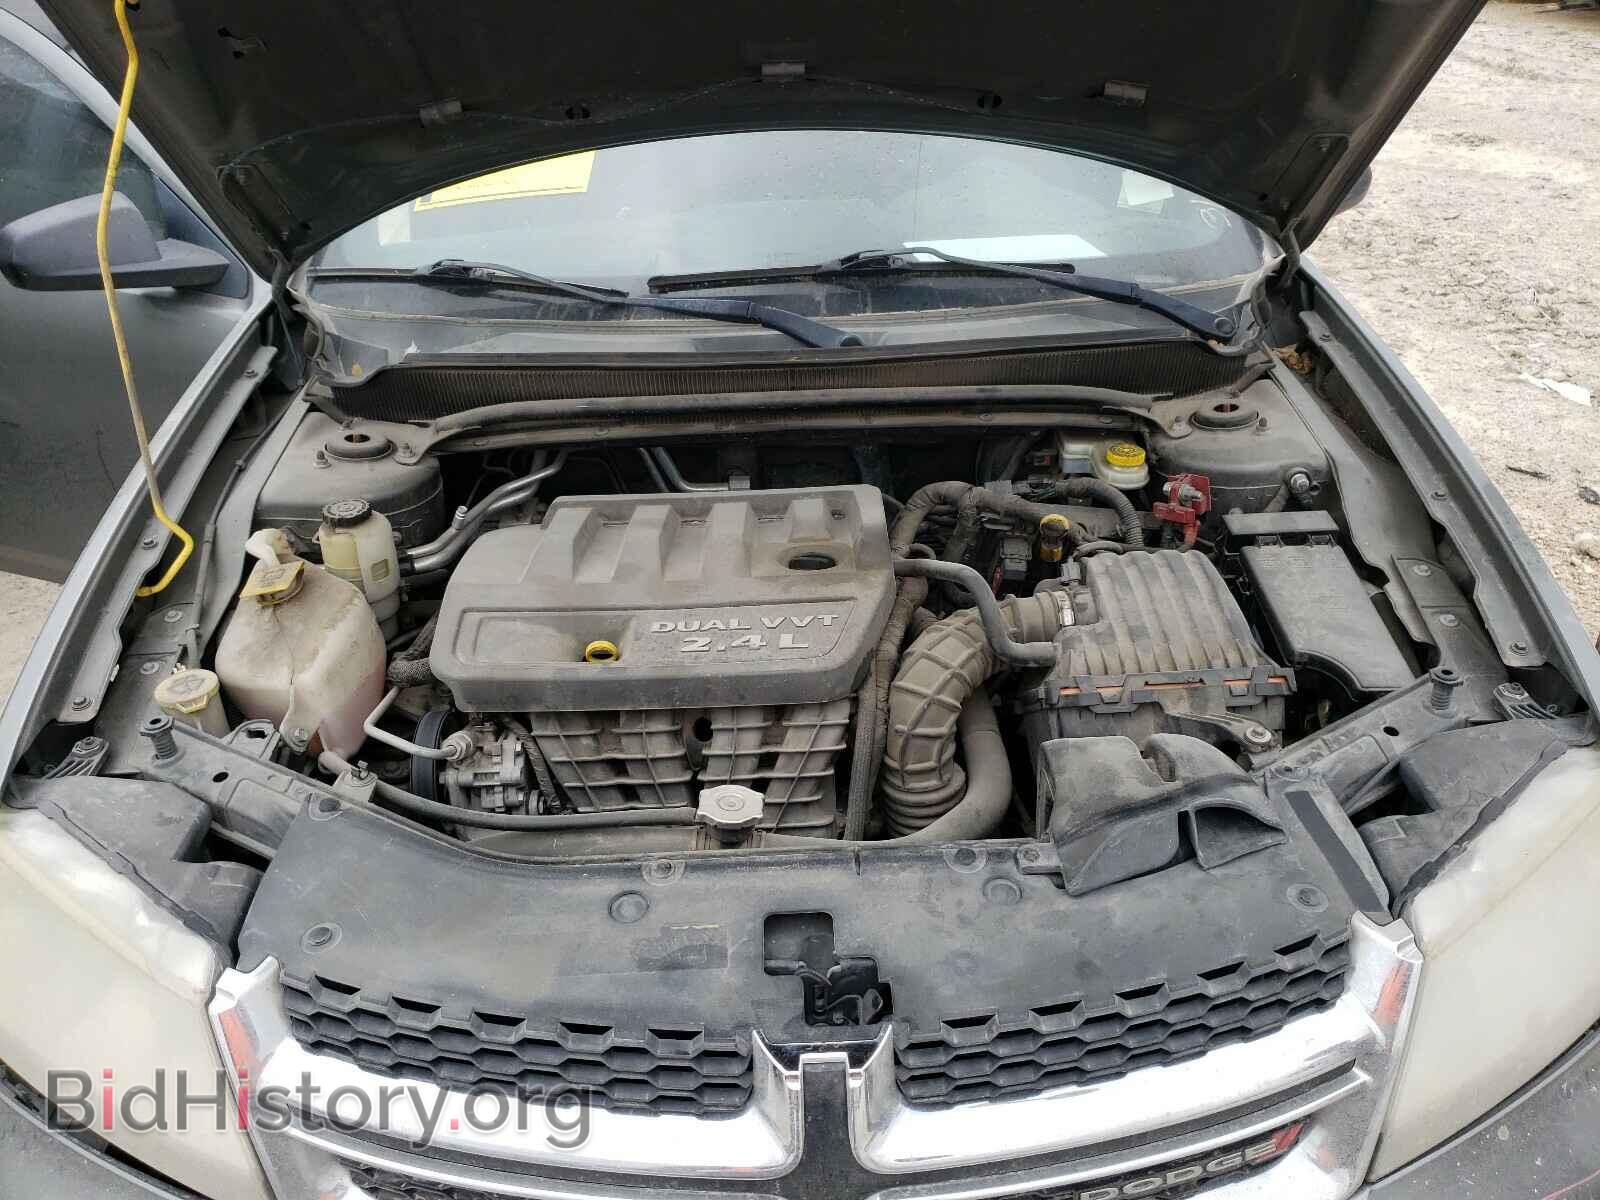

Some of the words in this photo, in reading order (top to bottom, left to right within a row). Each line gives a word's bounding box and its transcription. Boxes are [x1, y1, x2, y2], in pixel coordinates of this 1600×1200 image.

[651, 615, 752, 633] DUAL
[760, 614, 839, 629] VVT
[1080, 1138, 1278, 1200] DODGE
